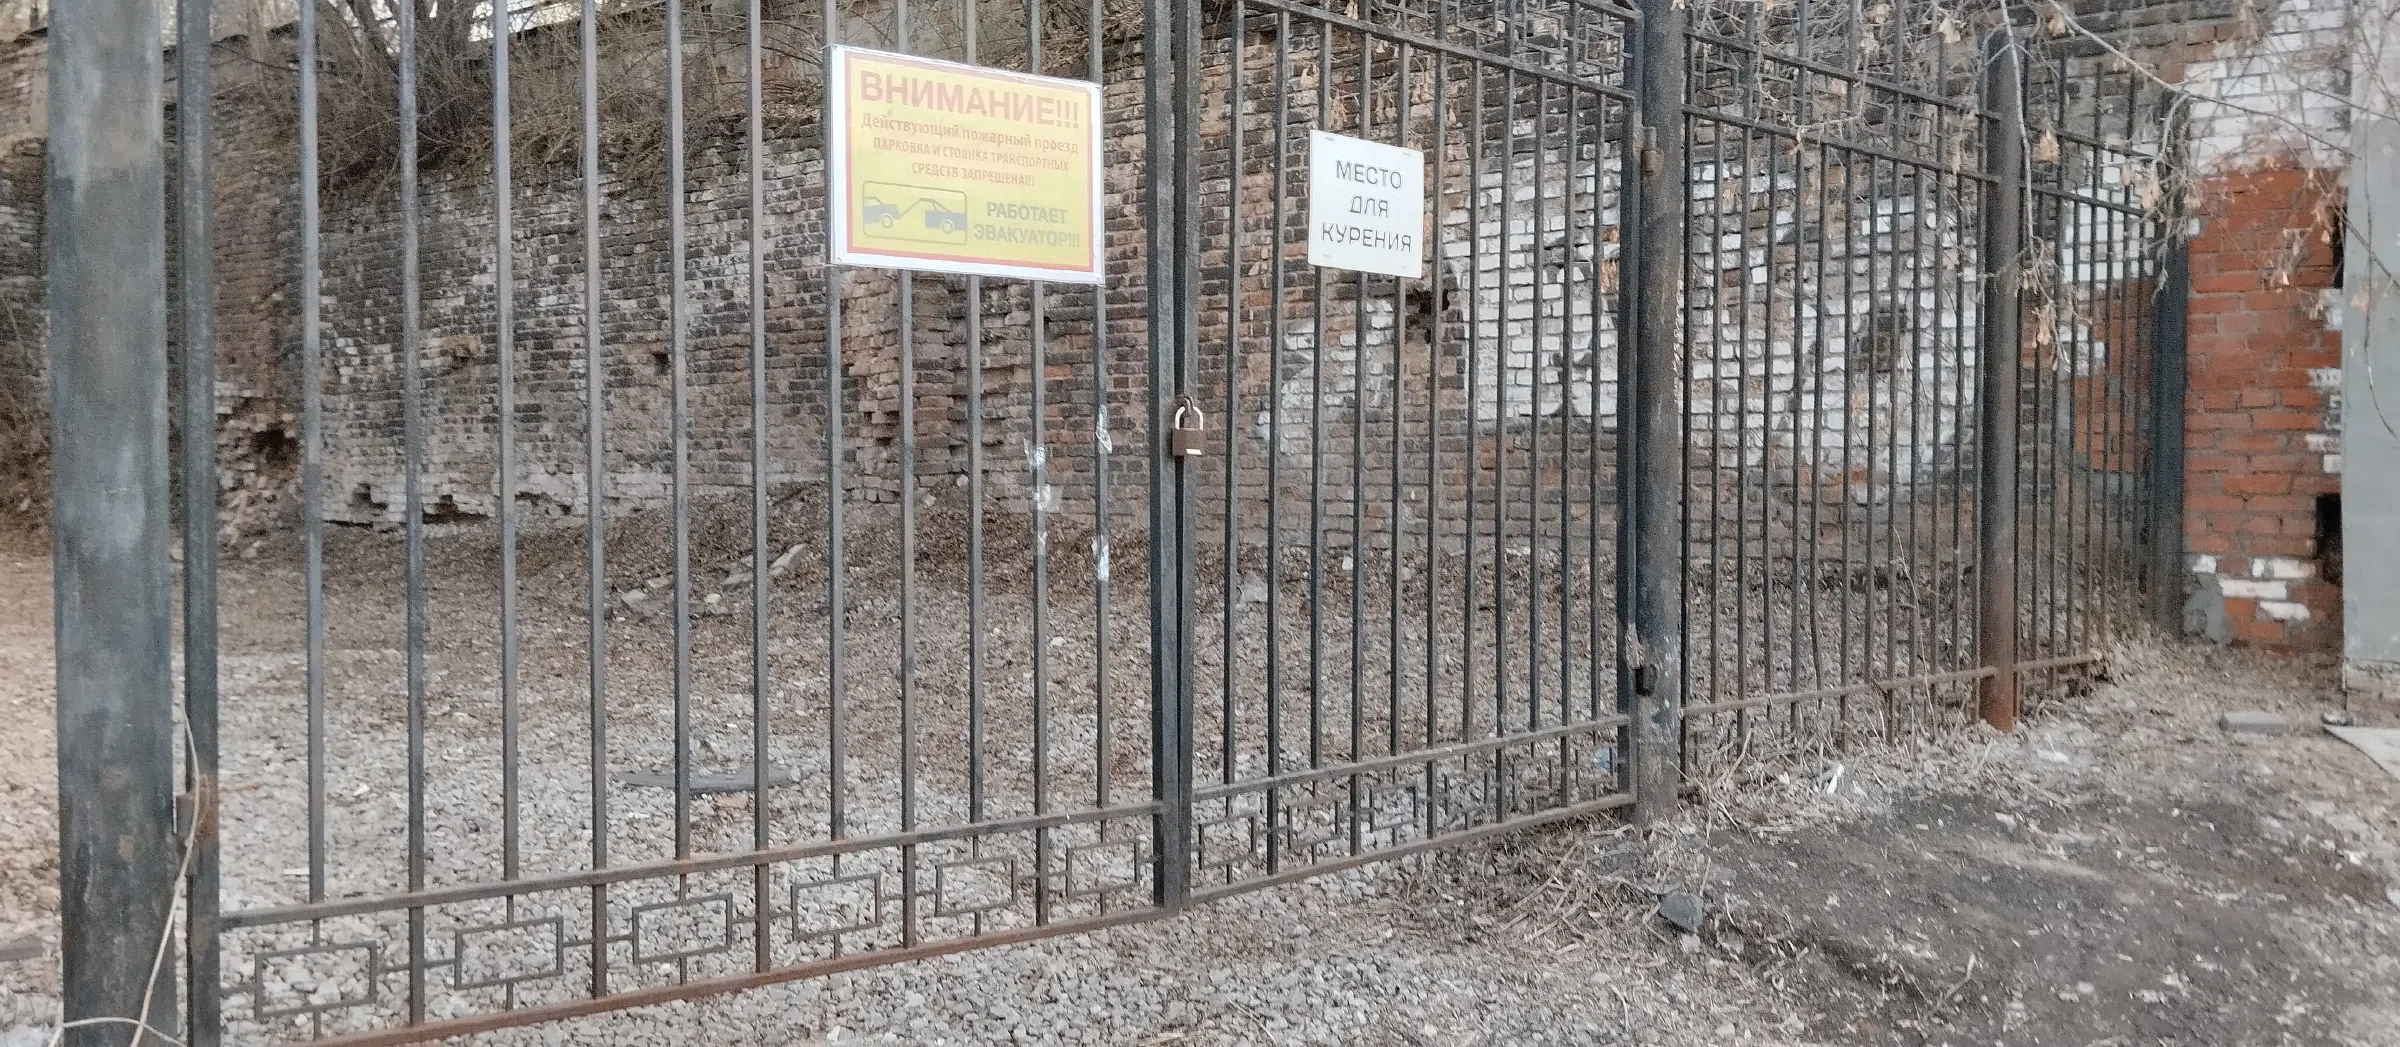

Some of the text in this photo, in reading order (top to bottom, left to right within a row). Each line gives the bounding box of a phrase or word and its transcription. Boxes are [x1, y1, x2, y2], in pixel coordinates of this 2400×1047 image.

[860, 70, 1080, 129] ВНИМАНИЕ!!!
[861, 112, 1079, 155] Действующий пожарный проезд
[873, 137, 1069, 172] ПАРКОВКА И СТОЯНКА ТРАНСПОРТНЫХ
[912, 162, 958, 179] СРЕДСТВ
[1335, 159, 1402, 189] МЕСТО
[986, 201, 1068, 225] РАБОТАЕТ
[1350, 195, 1389, 218] ДЛЯ
[973, 223, 1080, 248] ЭВАКУАТОР!!!
[1321, 221, 1412, 253] КУРЕНИЯ
